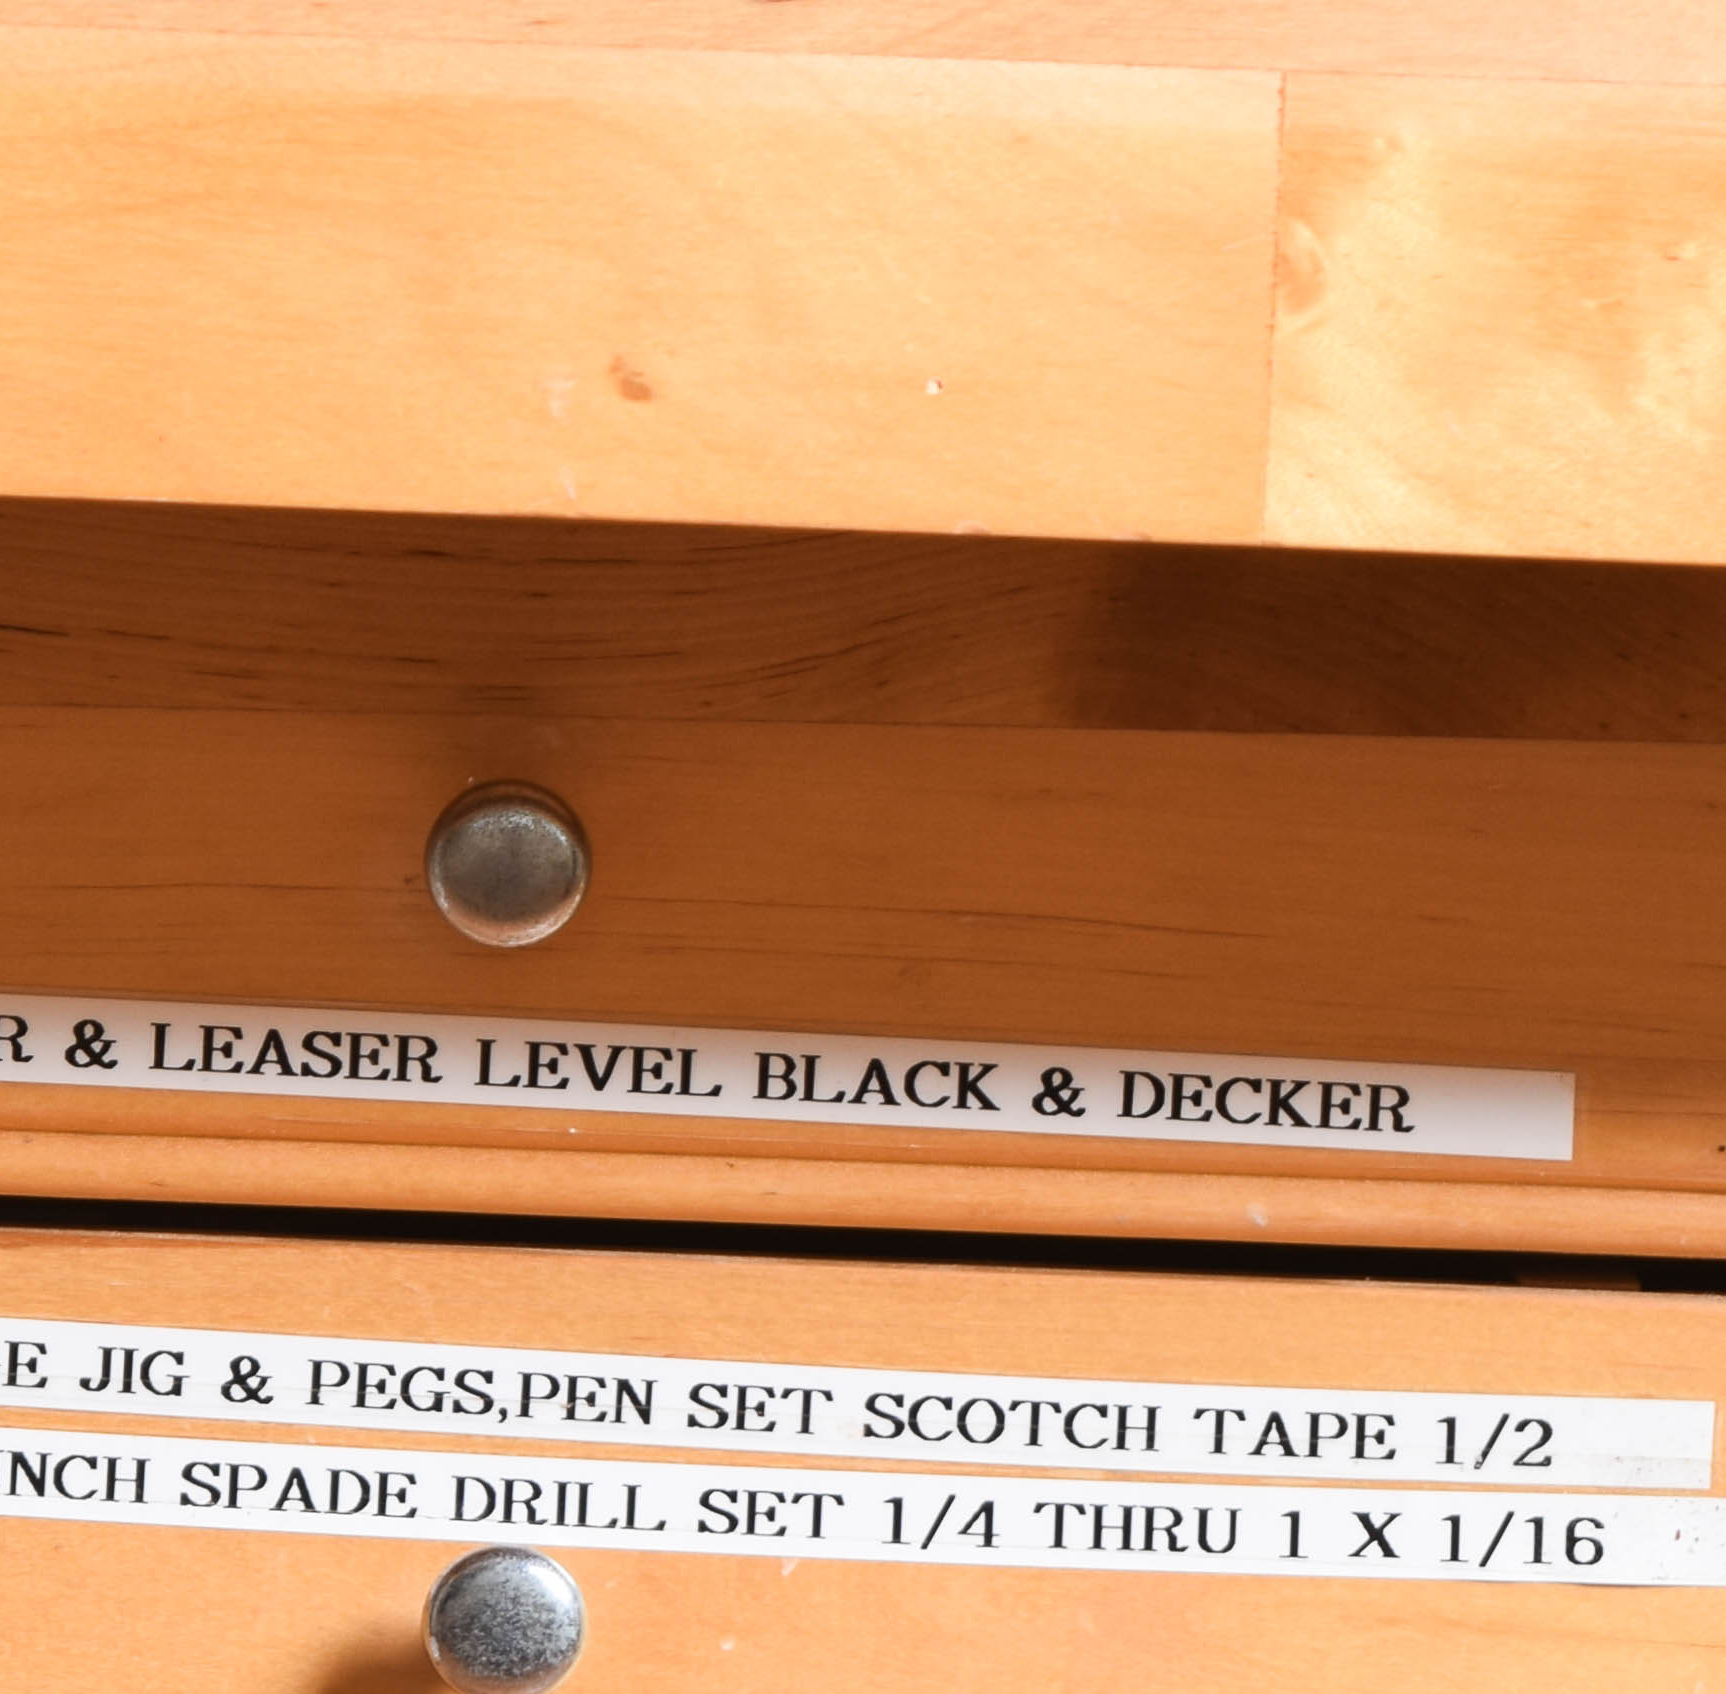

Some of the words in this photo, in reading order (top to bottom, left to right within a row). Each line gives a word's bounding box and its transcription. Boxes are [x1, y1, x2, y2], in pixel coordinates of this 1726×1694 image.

[64, 1018, 119, 1070] &
[148, 1022, 444, 1084] LEASER
[474, 1038, 723, 1098] LEVEL
[752, 1051, 1001, 1112] BLACK
[1031, 1066, 1087, 1118] &
[1116, 1069, 1416, 1134] DECKER
[79, 1346, 190, 1397] JIG
[220, 1355, 274, 1405] &
[686, 1382, 834, 1435] SET
[863, 1392, 1161, 1452] SCOTCH
[1192, 1408, 1397, 1461] TAPE
[1437, 1413, 1553, 1470] 1/2
[179, 1461, 418, 1518] SPADE
[452, 1475, 667, 1531] DRILL
[697, 1488, 845, 1538] SET
[884, 1494, 999, 1547] 1/4
[1033, 1502, 1241, 1554] THRU
[1282, 1510, 1307, 1559] 1
[1348, 1511, 1401, 1559] X
[1441, 1511, 1605, 1568] 1/16
